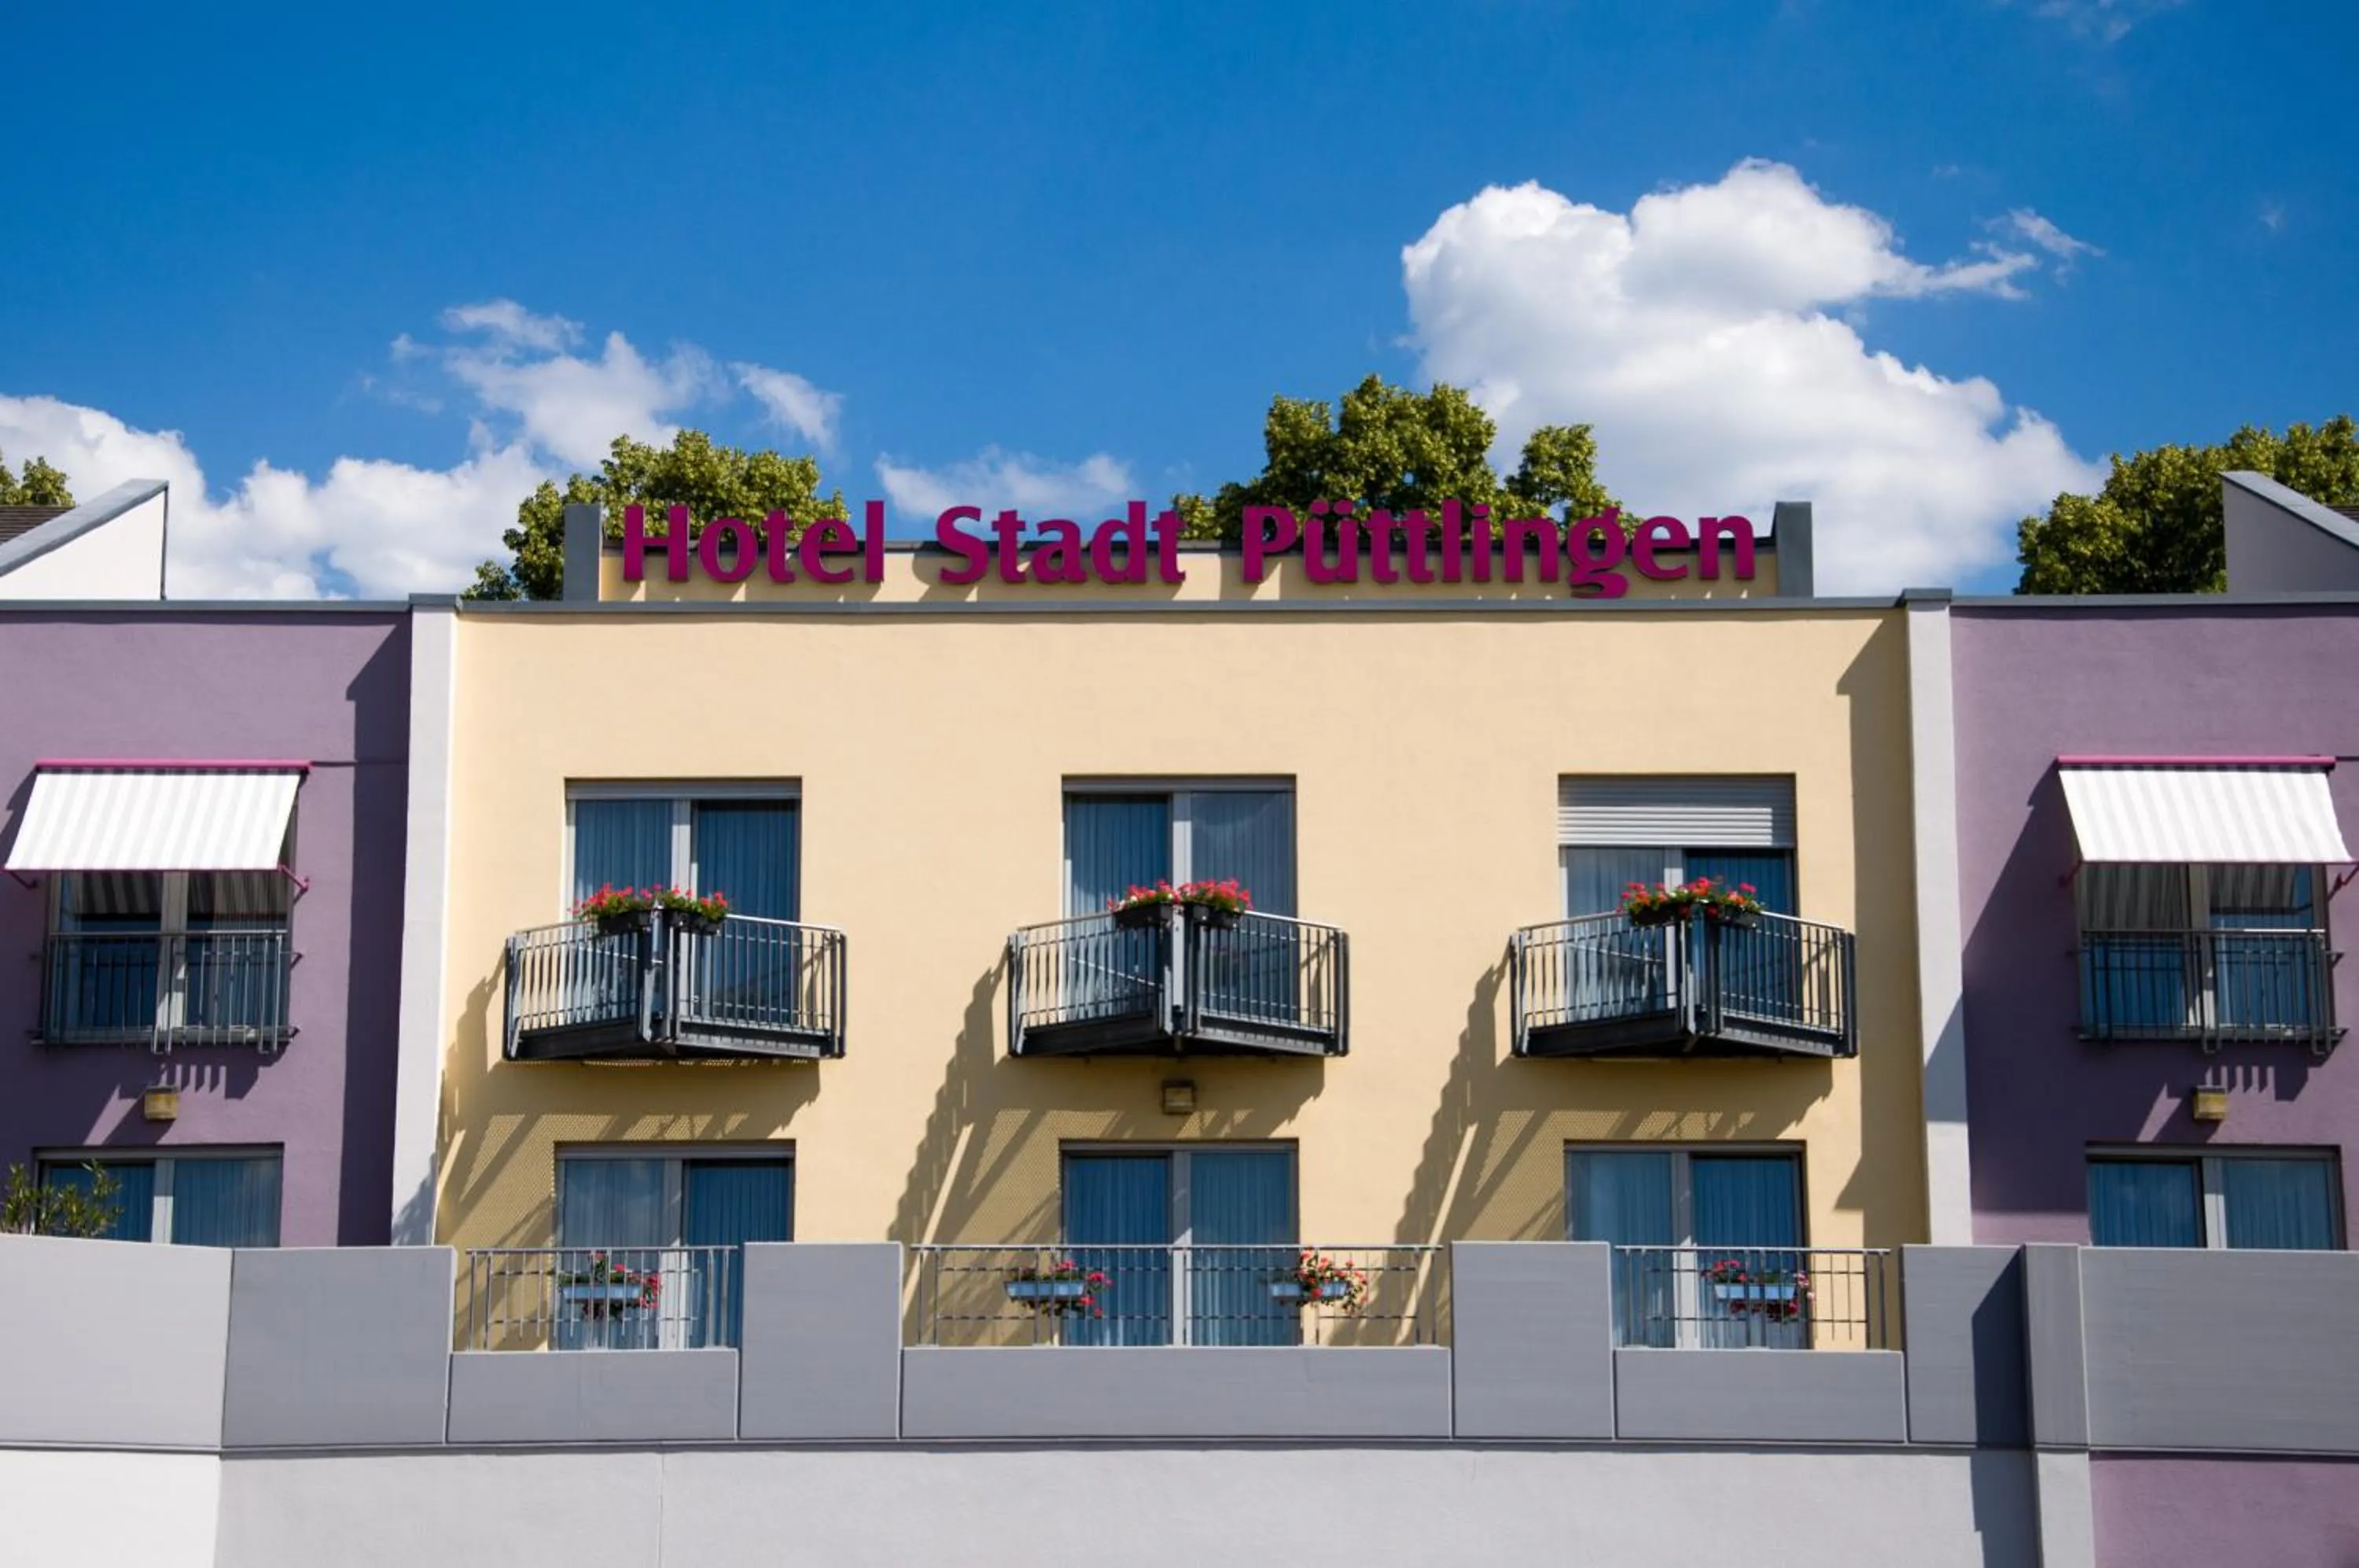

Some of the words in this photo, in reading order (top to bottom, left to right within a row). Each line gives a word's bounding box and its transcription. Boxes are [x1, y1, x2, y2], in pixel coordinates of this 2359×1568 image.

[623, 500, 885, 583] Hotel
[936, 501, 1186, 584] Stadt
[1242, 499, 1755, 599] Püttlingen
